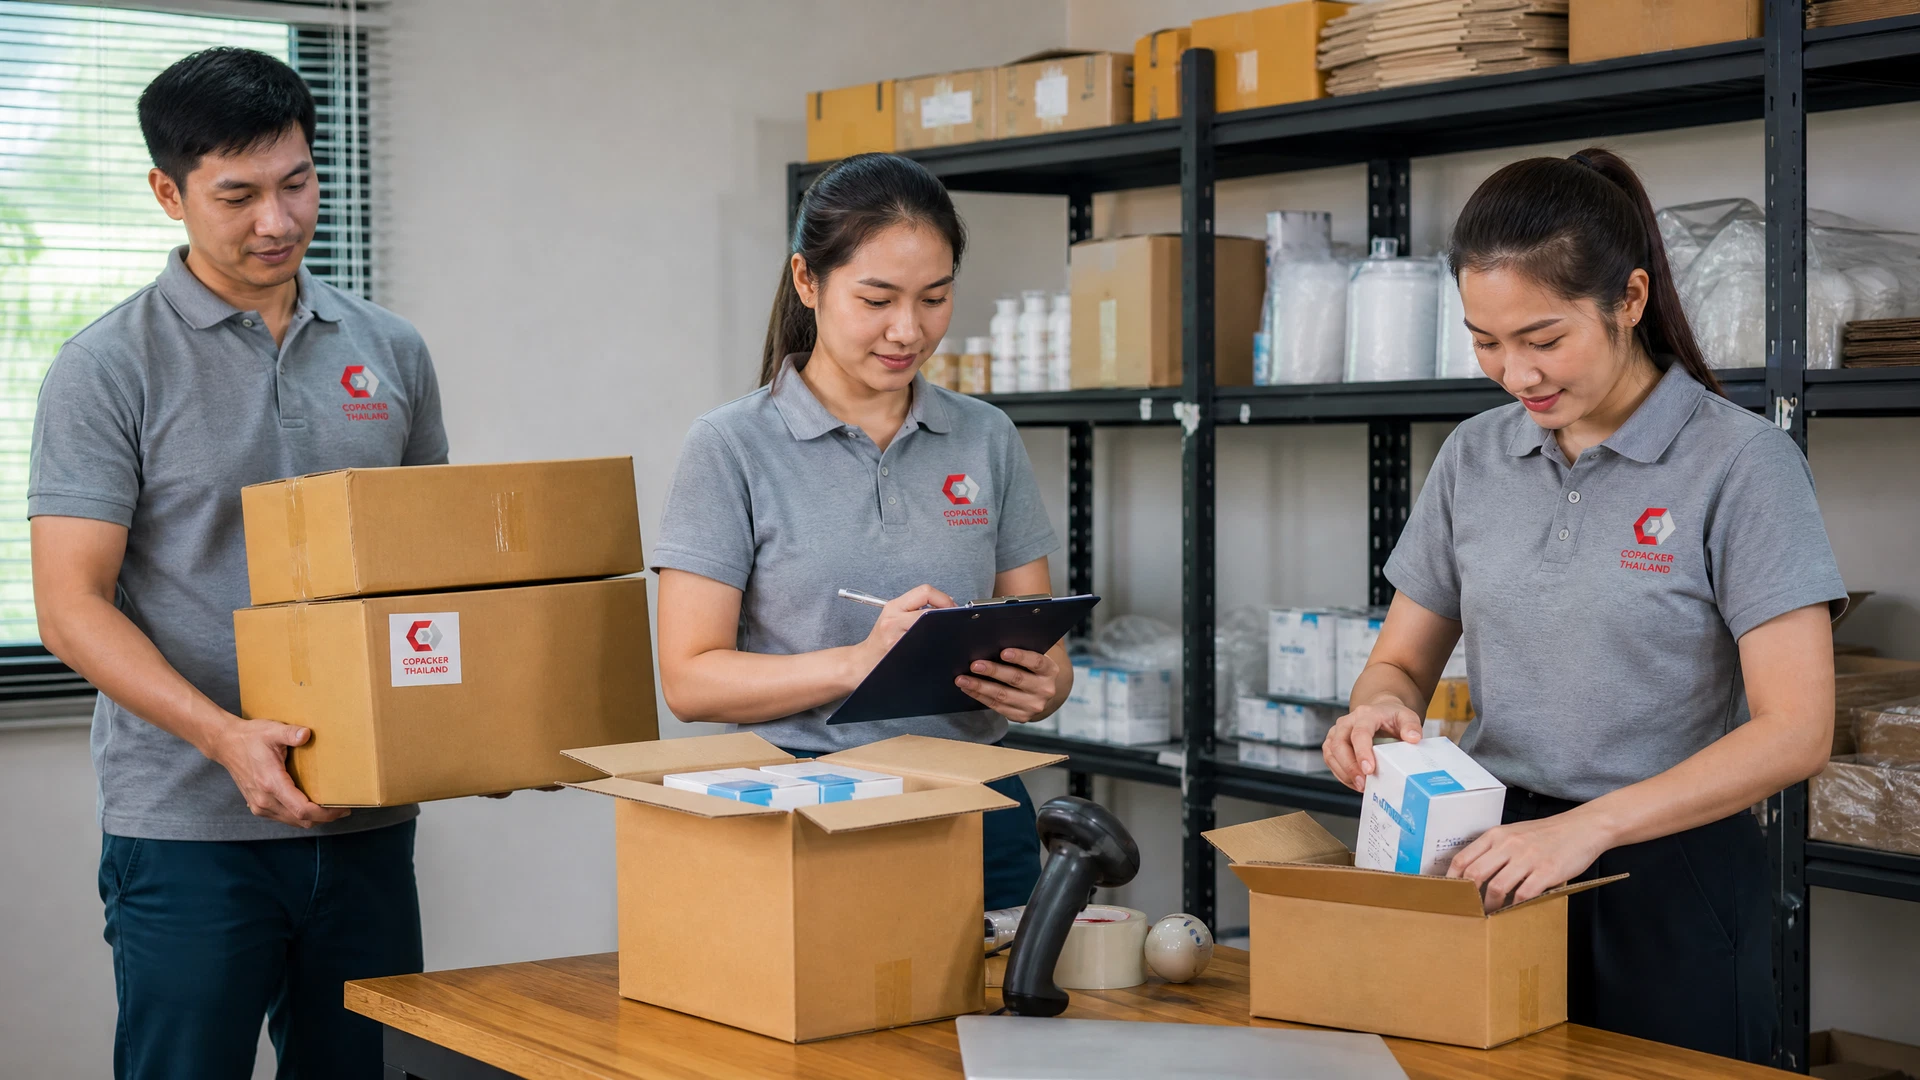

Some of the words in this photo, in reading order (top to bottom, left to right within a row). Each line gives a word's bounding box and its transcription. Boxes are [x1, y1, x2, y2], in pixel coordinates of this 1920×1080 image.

[342, 403, 388, 412] COPACKER
[345, 412, 389, 421] THAILAND
[943, 508, 988, 517] COPACKER
[947, 517, 989, 526] THAILAND
[1620, 549, 1675, 563] COPACKER
[1620, 560, 1671, 574] THAILAND
[402, 656, 449, 665] COPACKER
[404, 666, 449, 675] THAILAND
